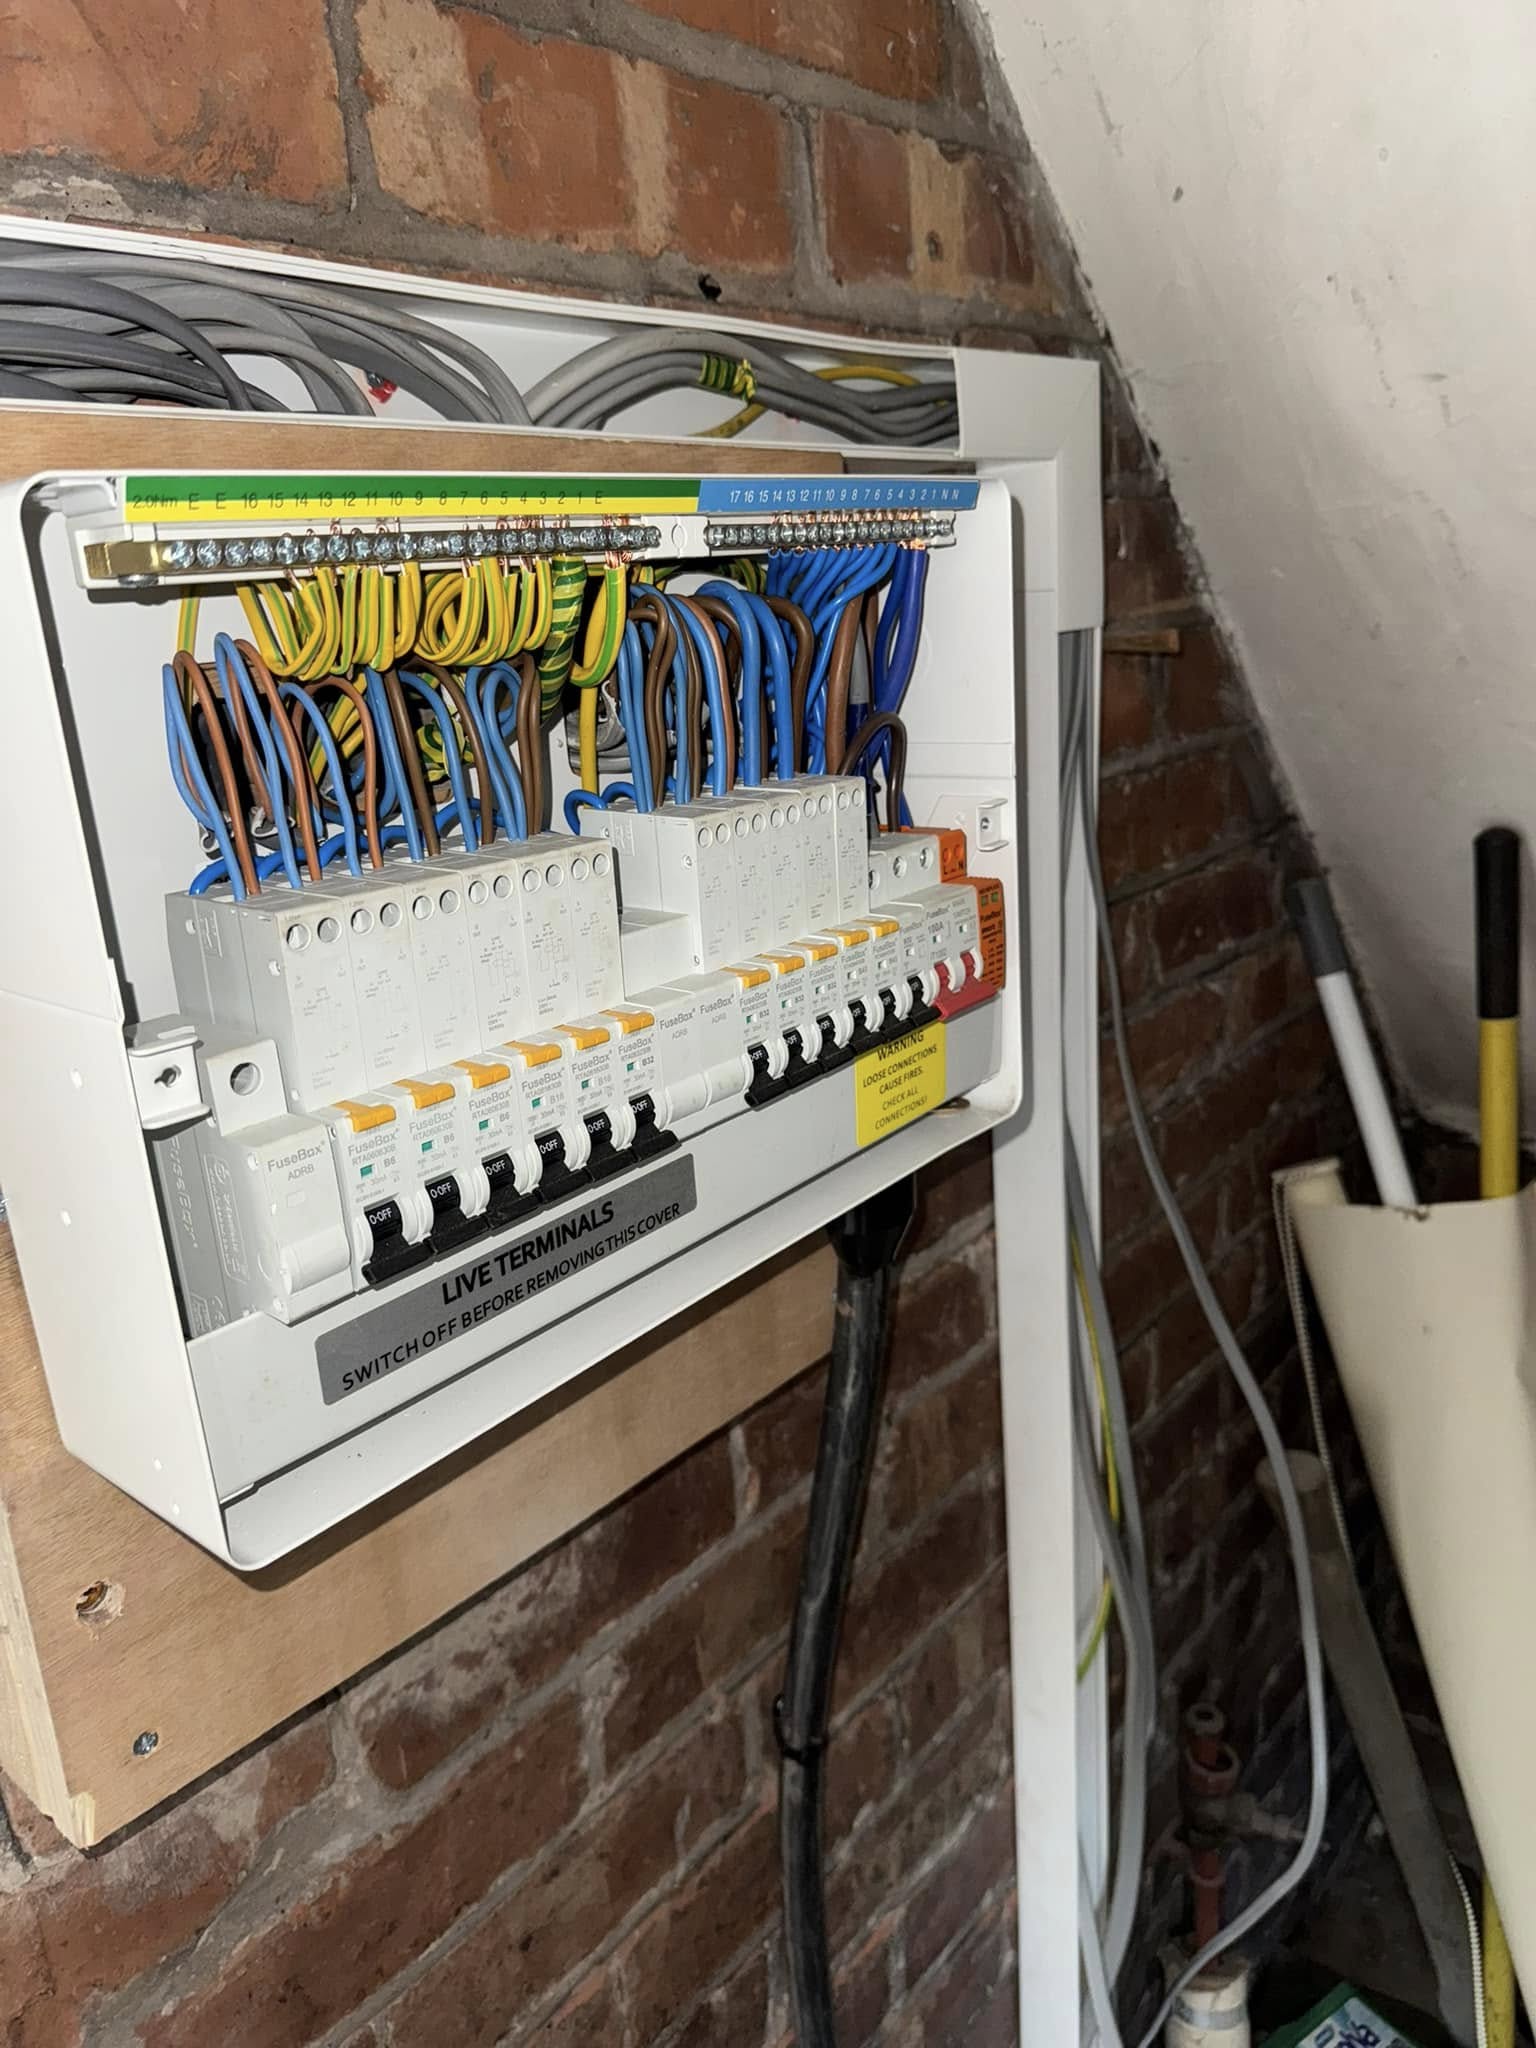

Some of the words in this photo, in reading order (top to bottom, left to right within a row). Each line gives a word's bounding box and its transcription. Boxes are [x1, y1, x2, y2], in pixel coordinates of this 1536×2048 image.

[133, 495, 178, 509] 2.0Nm
[188, 493, 200, 510] E
[216, 492, 226, 510] E
[242, 491, 258, 509] 16
[267, 491, 284, 509] 15
[293, 492, 308, 508] 14
[318, 491, 333, 508] 13
[342, 491, 356, 507] 12
[365, 491, 378, 506] 11
[389, 490, 403, 506] 10
[415, 490, 424, 506] 9
[439, 490, 447, 505] 8
[460, 490, 469, 505] 7
[480, 490, 488, 505] 6
[500, 490, 509, 505] 5
[519, 490, 528, 505] 4
[539, 490, 547, 505] 3
[557, 490, 566, 505] 2
[577, 490, 583, 504] 1
[594, 490, 603, 505] E
[730, 489, 741, 503] 17
[744, 490, 754, 503] 16
[759, 490, 769, 503] 15
[773, 489, 782, 502] 14
[786, 489, 796, 502] 13
[799, 489, 810, 502] 12
[813, 489, 822, 502] 11
[825, 489, 835, 501] 10
[840, 489, 847, 501] 9
[851, 489, 858, 501] 8
[864, 489, 870, 500] 7
[874, 489, 880, 501] 6
[886, 489, 894, 500] 5
[898, 489, 904, 500] 4
[909, 489, 916, 500] 3
[920, 489, 928, 500] 2
[941, 489, 949, 500] N
[951, 489, 960, 500] N
[700, 997, 733, 1015] FuseBox
[739, 992, 768, 1008] FuseBox
[659, 1011, 694, 1030] FuseBox
[618, 1036, 653, 1056] FuseBox
[876, 1030, 924, 1062] WARNING
[571, 1054, 610, 1075] FuseBox
[641, 1055, 655, 1066] B32
[863, 1069, 886, 1088] LOOSE
[887, 1044, 938, 1076] CONNECTIONS
[521, 1070, 563, 1092] FuseBox
[879, 1075, 902, 1095] CAUSE
[903, 1065, 924, 1083] FIRES
[468, 1088, 511, 1111] FuseBox
[882, 1092, 905, 1111] CHECK
[907, 1086, 919, 1097] ALL
[409, 1110, 455, 1134] FuseBox
[347, 1132, 396, 1157] FuseBox
[443, 1132, 455, 1144] B6
[267, 1144, 322, 1173] FuseBox
[383, 1156, 396, 1168] B6
[287, 1163, 314, 1182] ADRB
[441, 1262, 492, 1305] LIVE
[494, 1200, 615, 1278] TERMINALS
[342, 1337, 419, 1391] SWITCH
[422, 1318, 457, 1348] OFF
[461, 1286, 524, 1330] BEFORE
[526, 1243, 604, 1295] REMOVING
[603, 1228, 636, 1253] THIS
[637, 1202, 681, 1236] COVER
